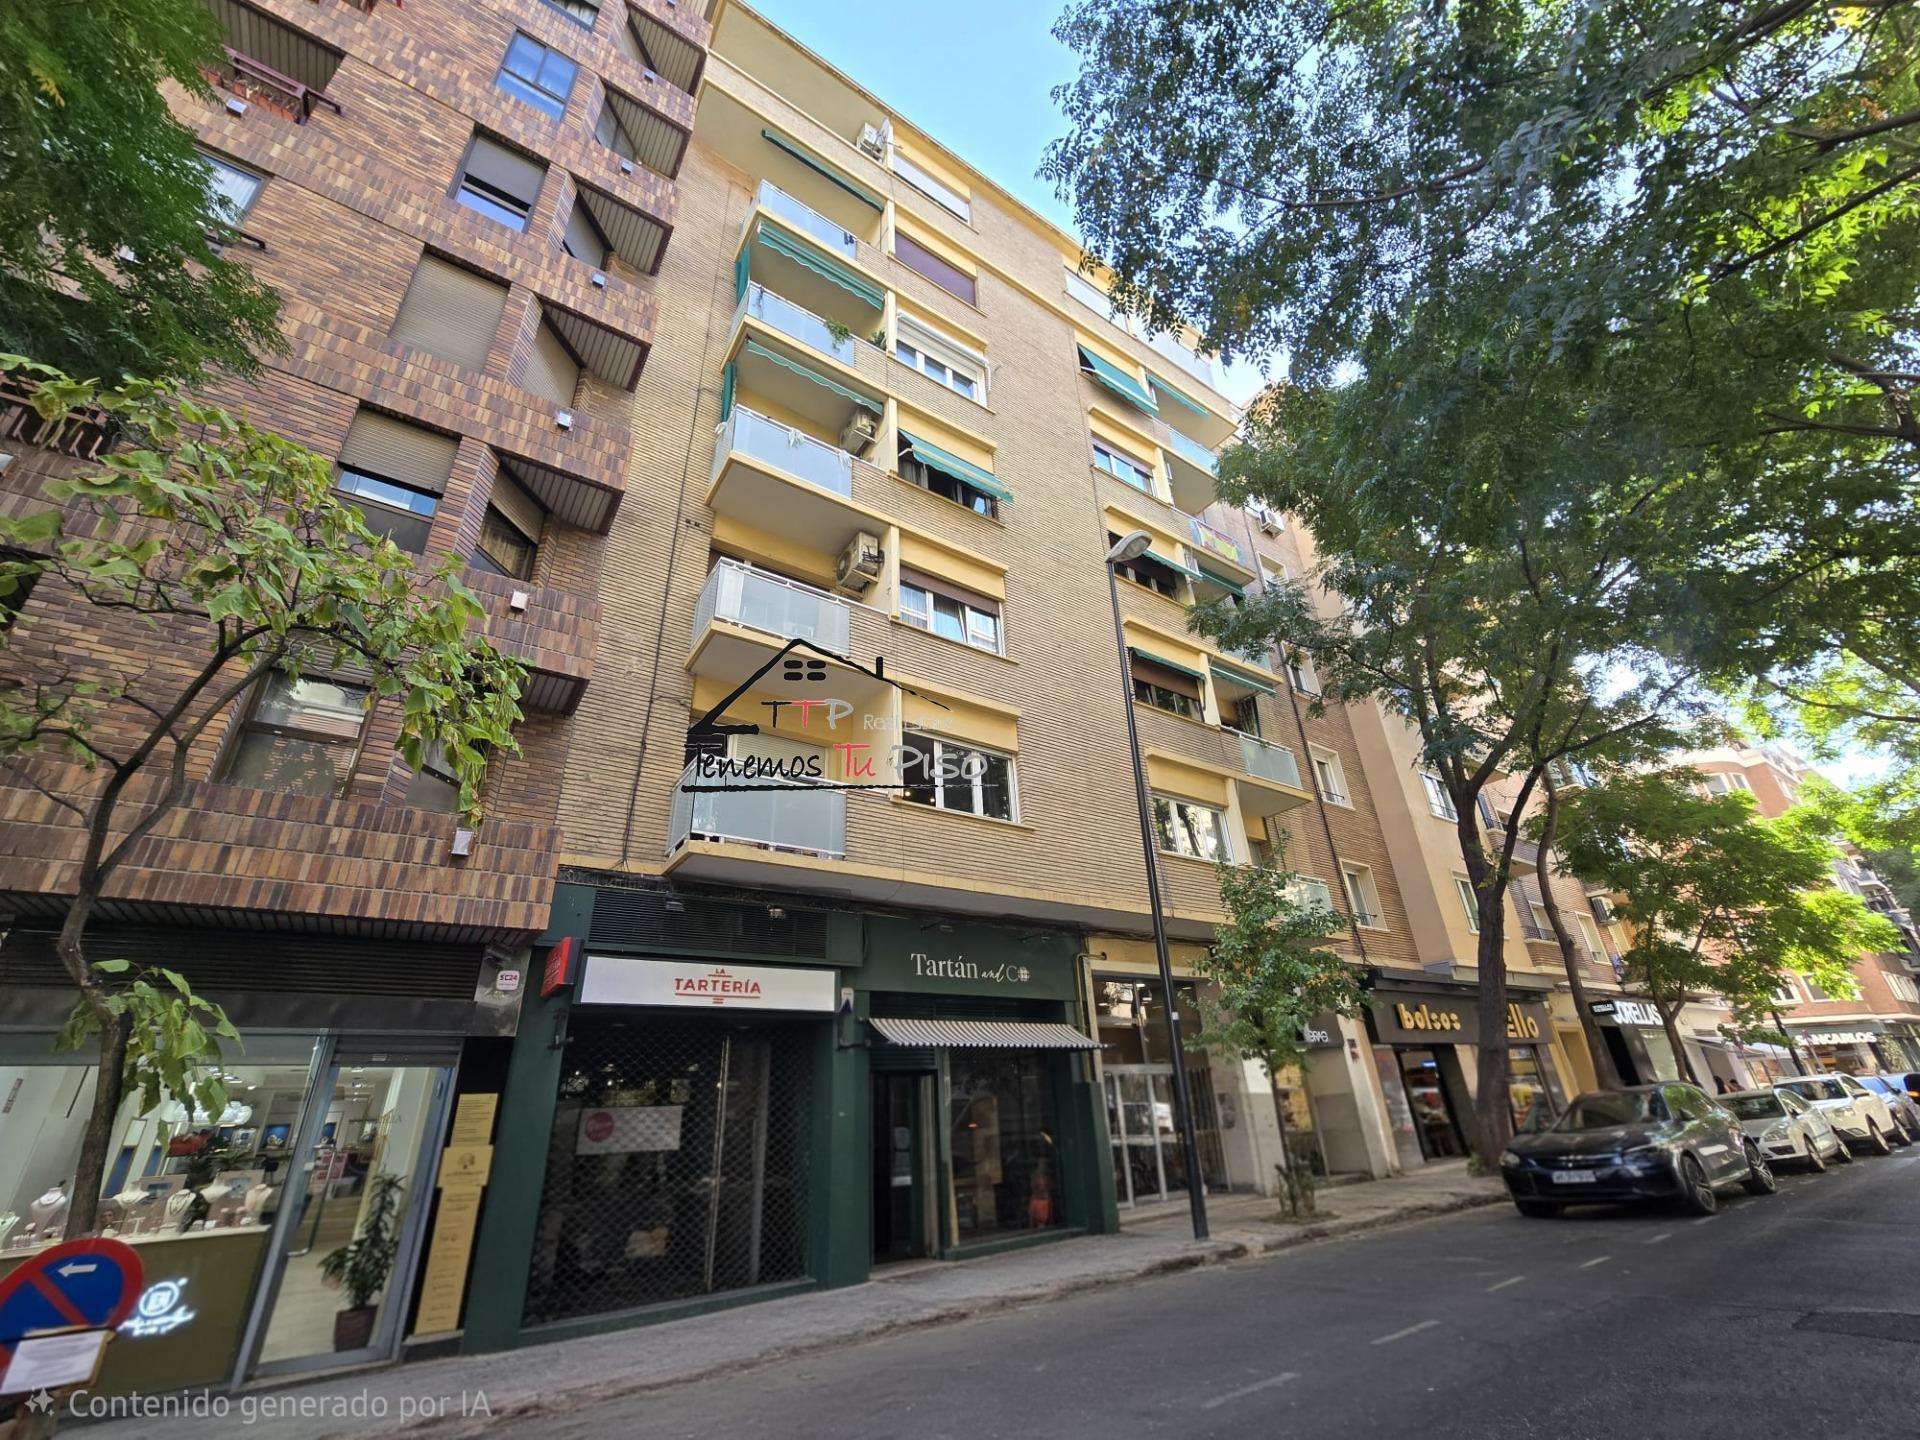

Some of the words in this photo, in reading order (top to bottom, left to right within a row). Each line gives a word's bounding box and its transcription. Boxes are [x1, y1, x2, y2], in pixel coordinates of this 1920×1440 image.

[910, 953, 978, 978] Tartán
[981, 963, 1005, 982] and
[674, 977, 761, 994] TARTERÍA
[1396, 1002, 1462, 1031] bolsos
